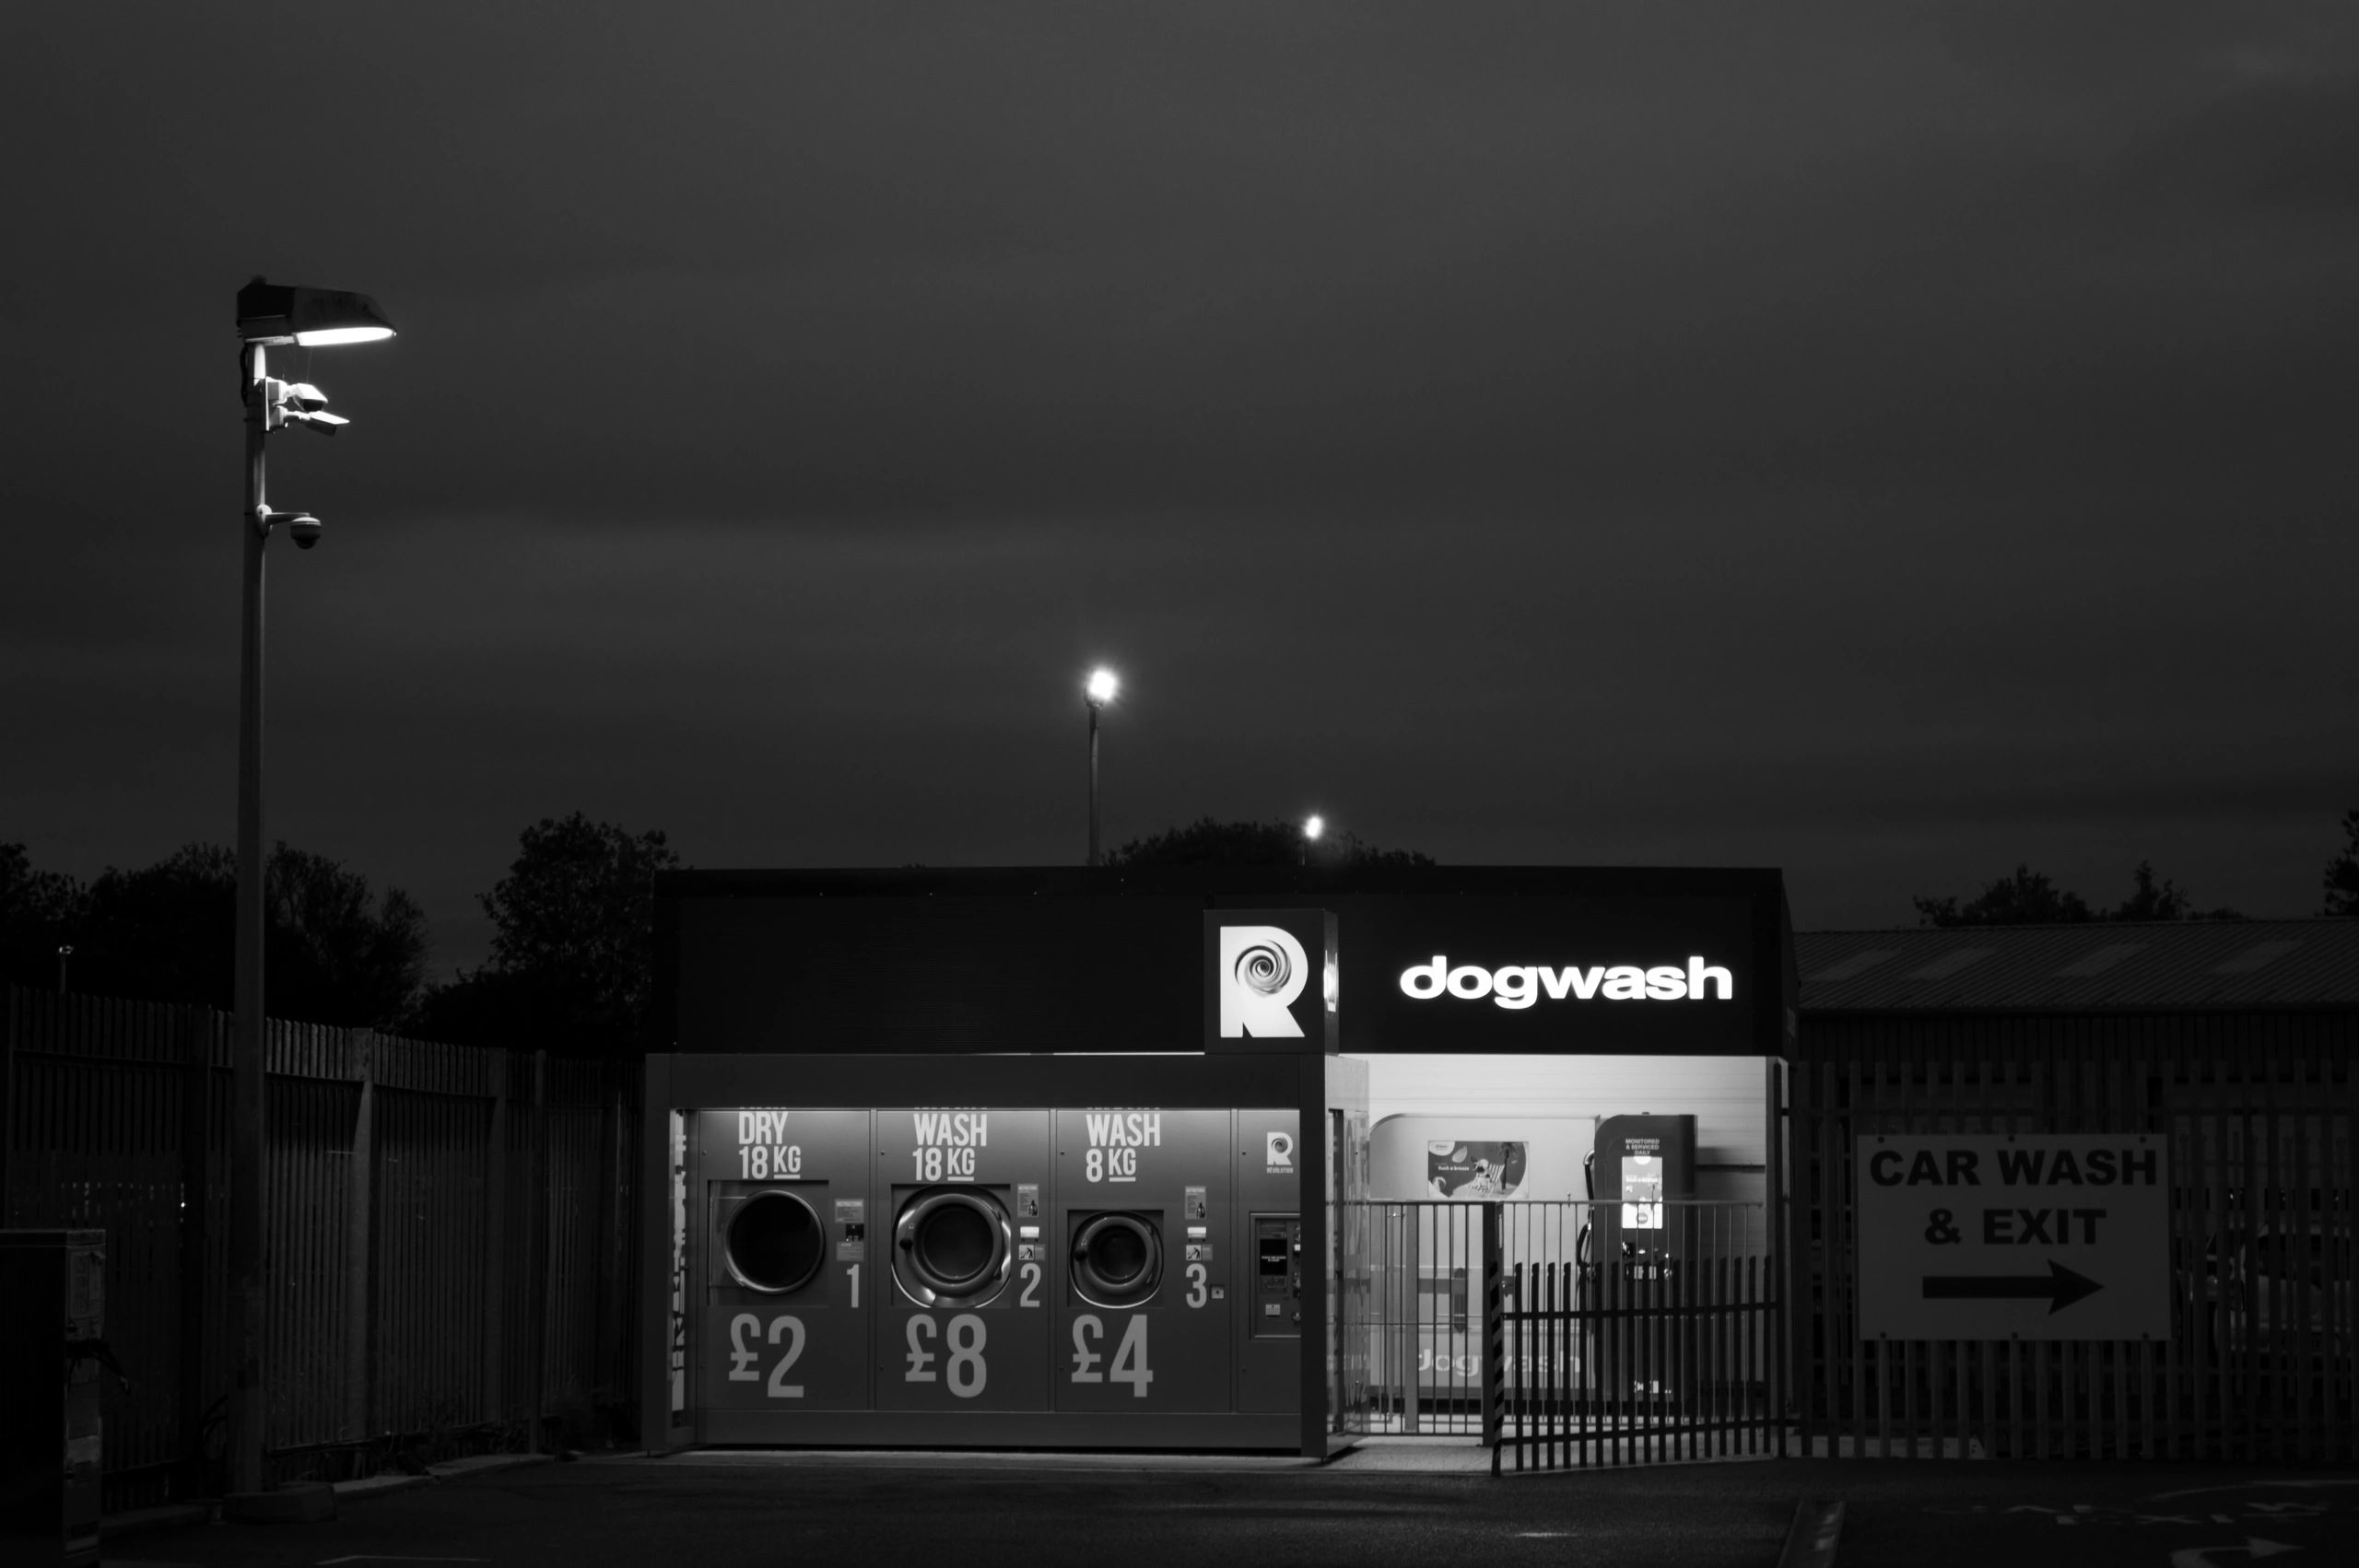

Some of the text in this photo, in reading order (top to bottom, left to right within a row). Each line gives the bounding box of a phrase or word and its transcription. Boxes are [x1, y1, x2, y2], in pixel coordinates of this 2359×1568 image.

[1400, 955, 1733, 1010] dogwash
[737, 1111, 789, 1144] DRY
[913, 1113, 988, 1146] WASH
[1086, 1113, 1161, 1146] WASH
[739, 1145, 802, 1179] 18 KG
[912, 1147, 976, 1180] 18 KG
[1086, 1148, 1136, 1182] 8 KG
[1871, 1150, 2157, 1186] CAR WASH
[1925, 1208, 2107, 1246] & EXIT
[846, 1263, 860, 1308] 1
[1020, 1263, 1041, 1307] 2
[1185, 1263, 1207, 1308] 3
[729, 1313, 806, 1398] £2
[905, 1313, 987, 1398] £8
[1072, 1314, 1154, 1398] £4
